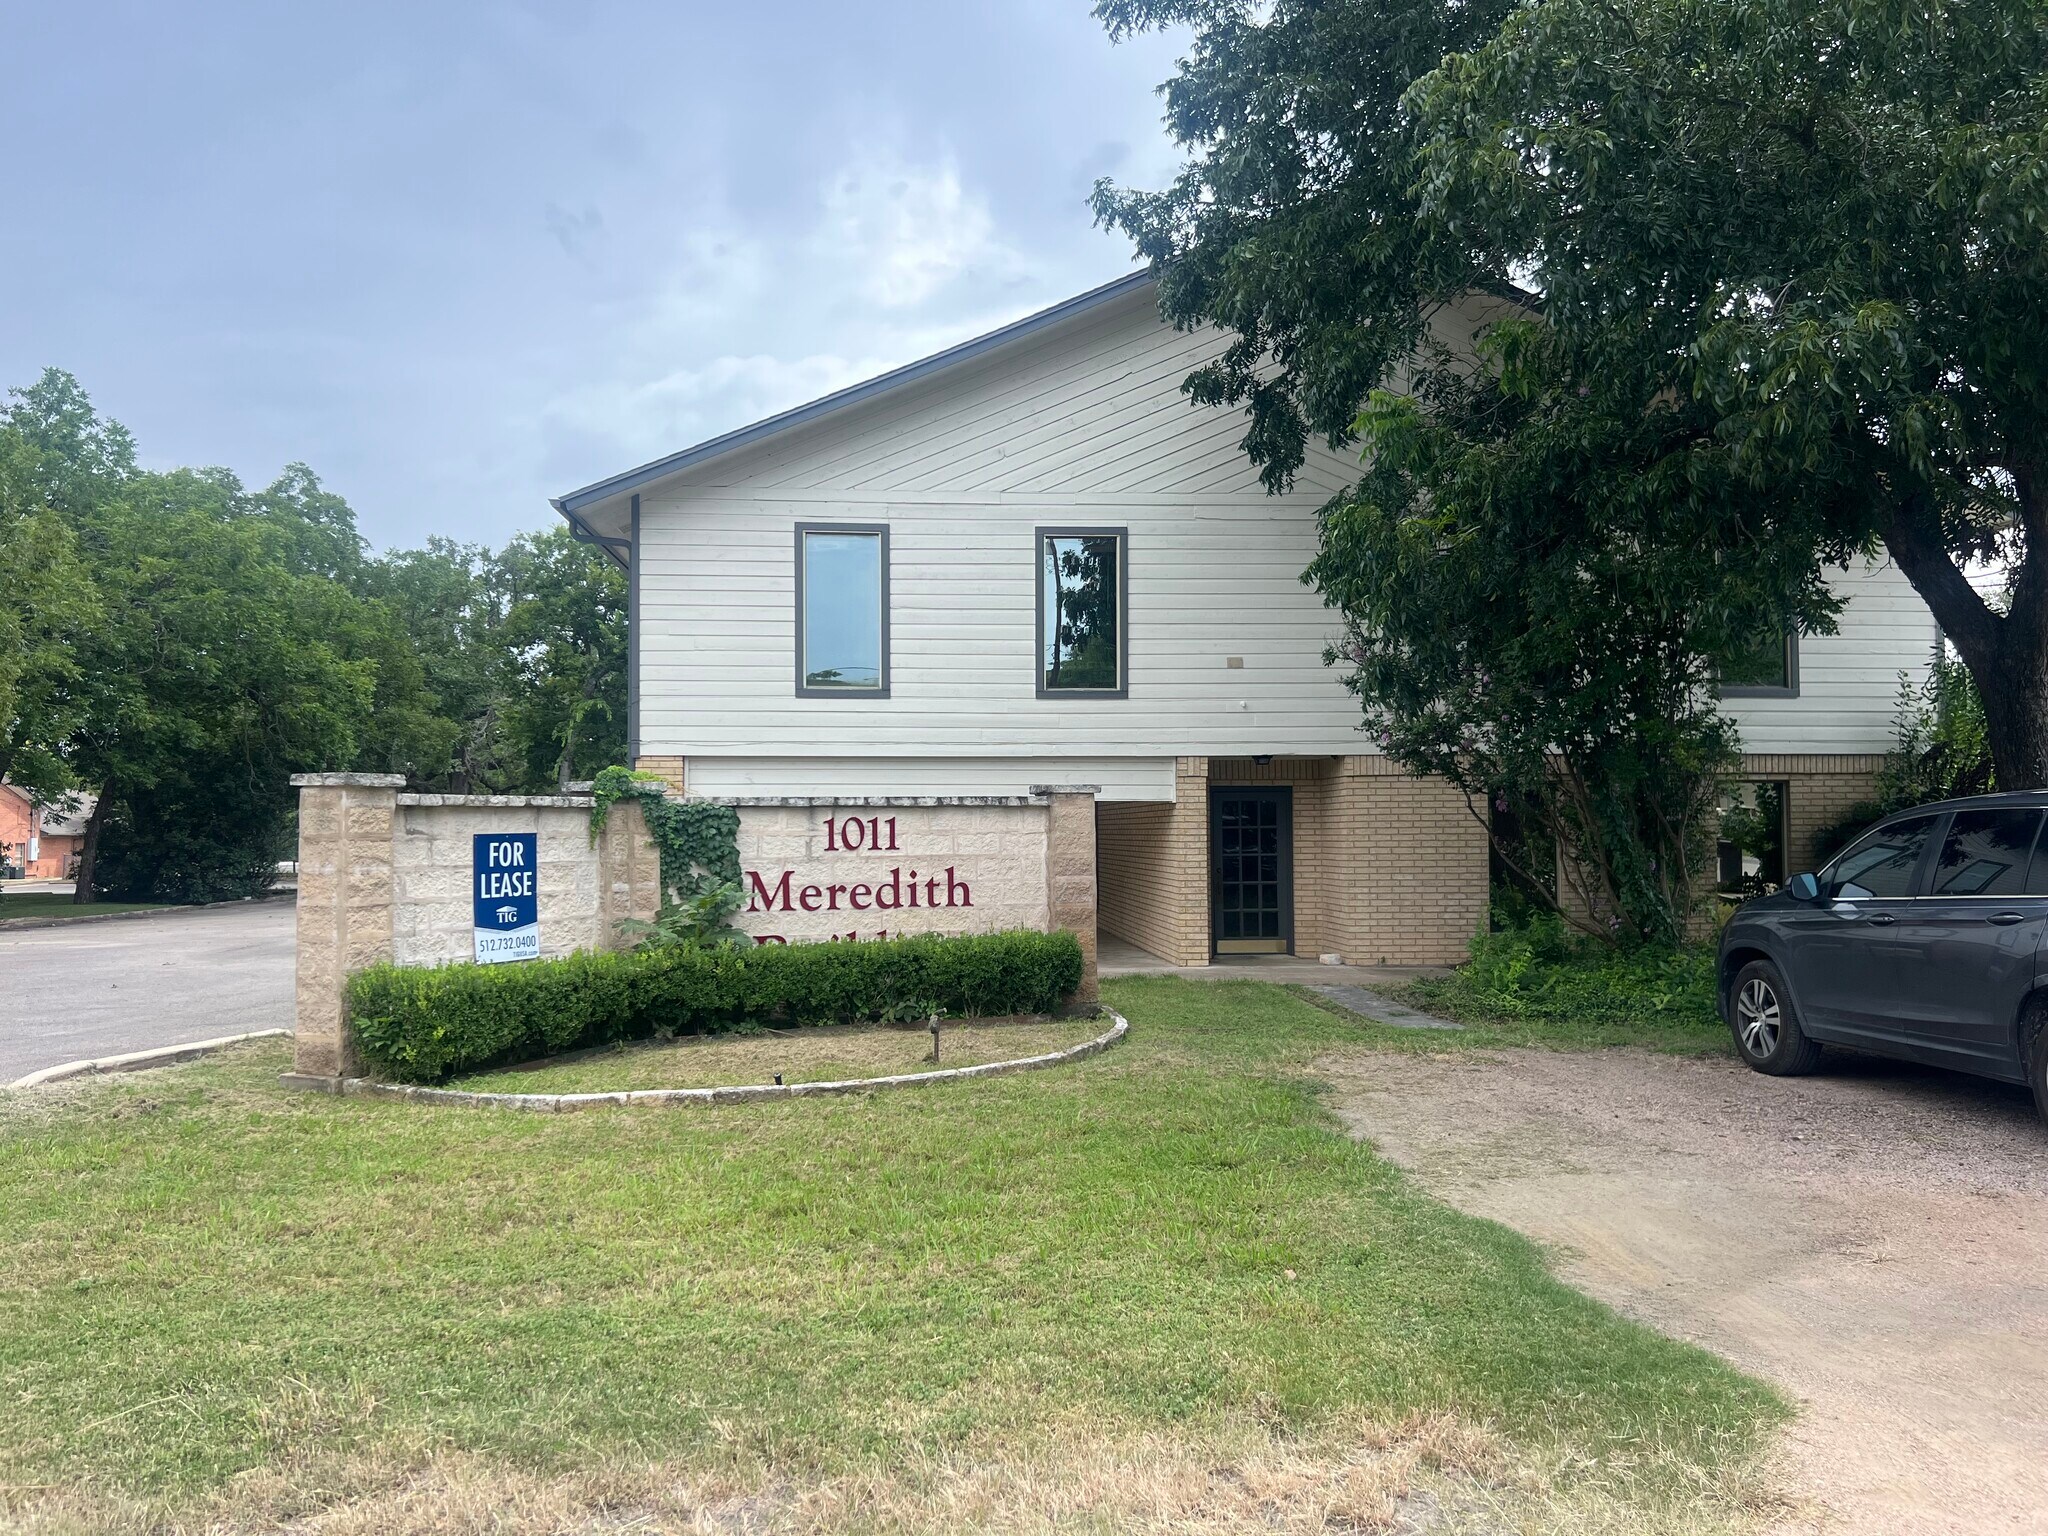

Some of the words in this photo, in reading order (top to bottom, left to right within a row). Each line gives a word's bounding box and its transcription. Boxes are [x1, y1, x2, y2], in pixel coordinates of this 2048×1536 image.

[823, 816, 900, 851] 1011
[489, 842, 524, 867] FOR
[481, 872, 532, 899] LEASE
[745, 866, 974, 912] Meredith
[496, 911, 517, 923] TIG
[480, 935, 536, 952] 512.732.0400
